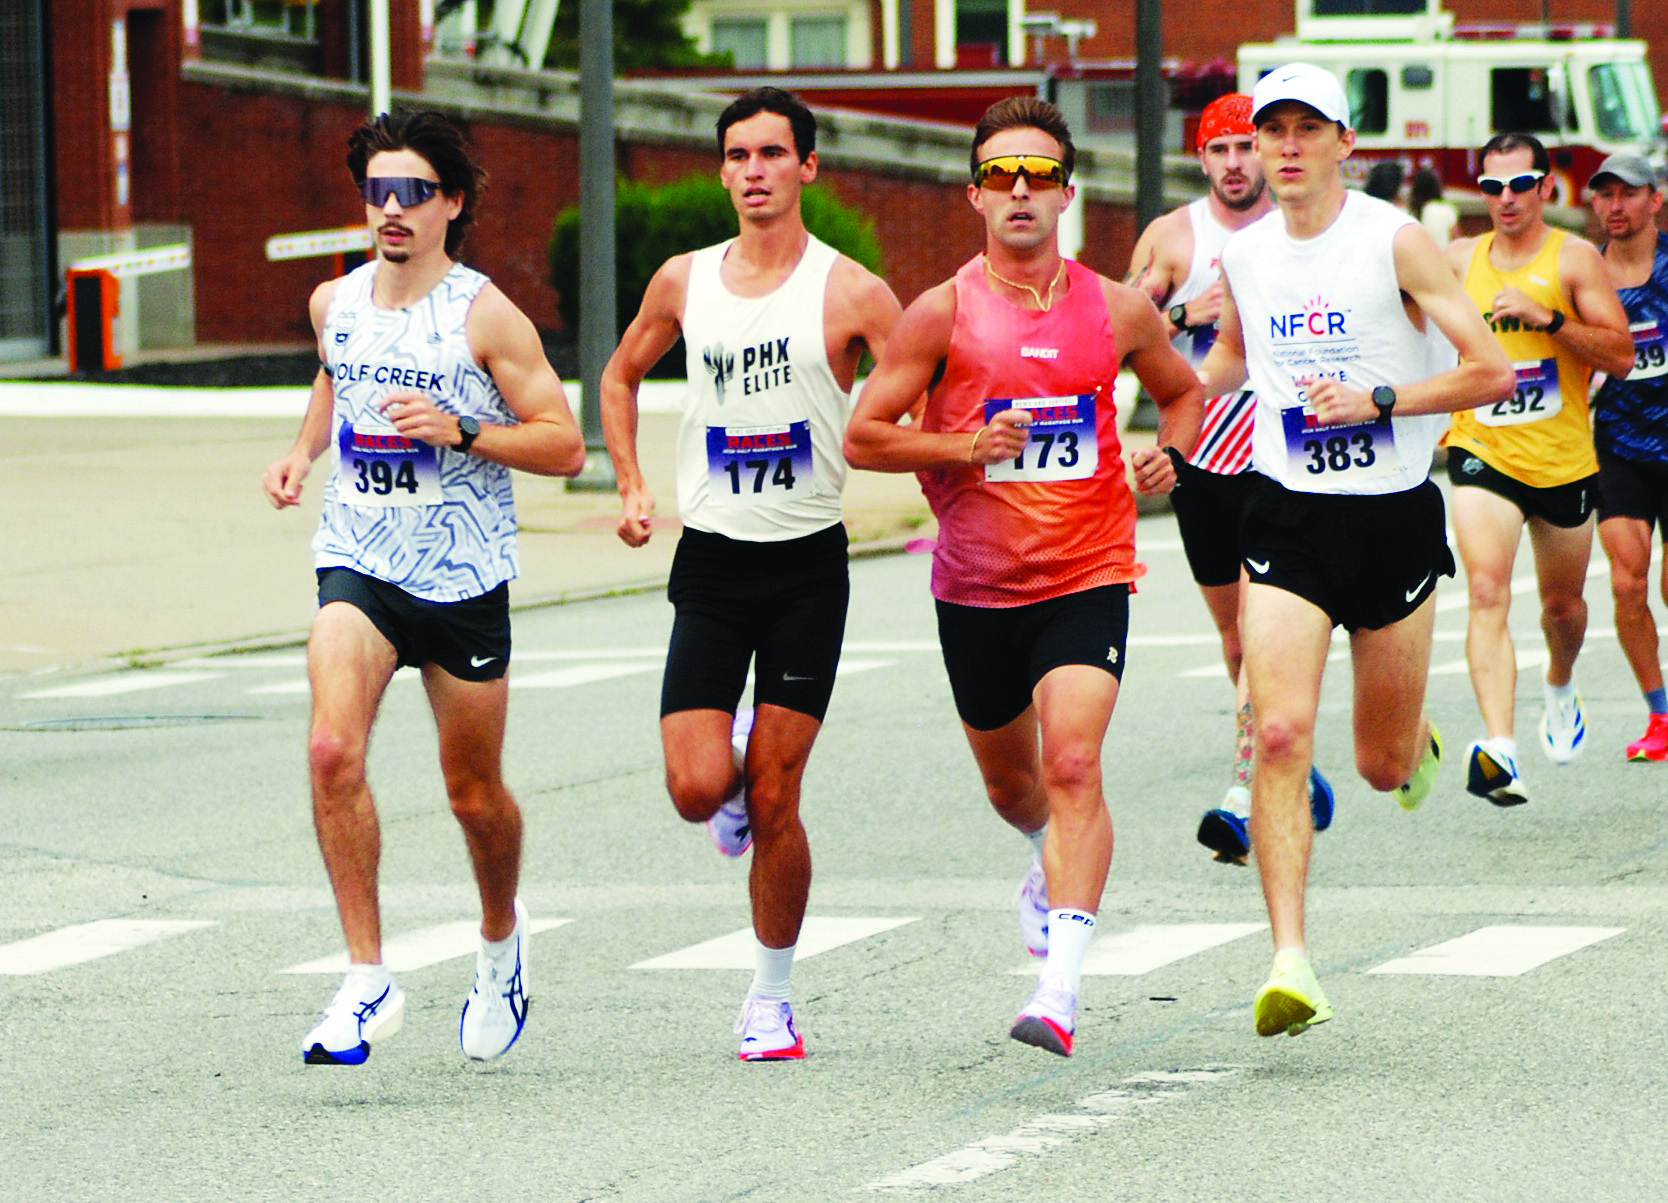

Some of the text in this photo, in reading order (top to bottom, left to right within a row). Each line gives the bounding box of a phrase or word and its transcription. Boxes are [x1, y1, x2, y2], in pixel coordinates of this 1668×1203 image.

[1271, 311, 1346, 339] NFCR
[743, 336, 790, 374] PHX
[1021, 346, 1059, 359] BANDIT
[1288, 358, 1317, 367] Cancer
[1320, 354, 1361, 364] Research
[1309, 345, 1359, 356] Foundation
[1635, 345, 1666, 370] 39
[336, 362, 446, 392] OLF CREEK
[743, 365, 792, 396] ELITE
[1031, 405, 1078, 421] ACES
[1492, 386, 1545, 417] 292
[353, 433, 412, 449] RACES
[727, 433, 791, 449] RACES
[1303, 432, 1376, 475] 383
[353, 458, 419, 496] 394
[724, 457, 796, 494] 174
[1058, 913, 1094, 926] cep
